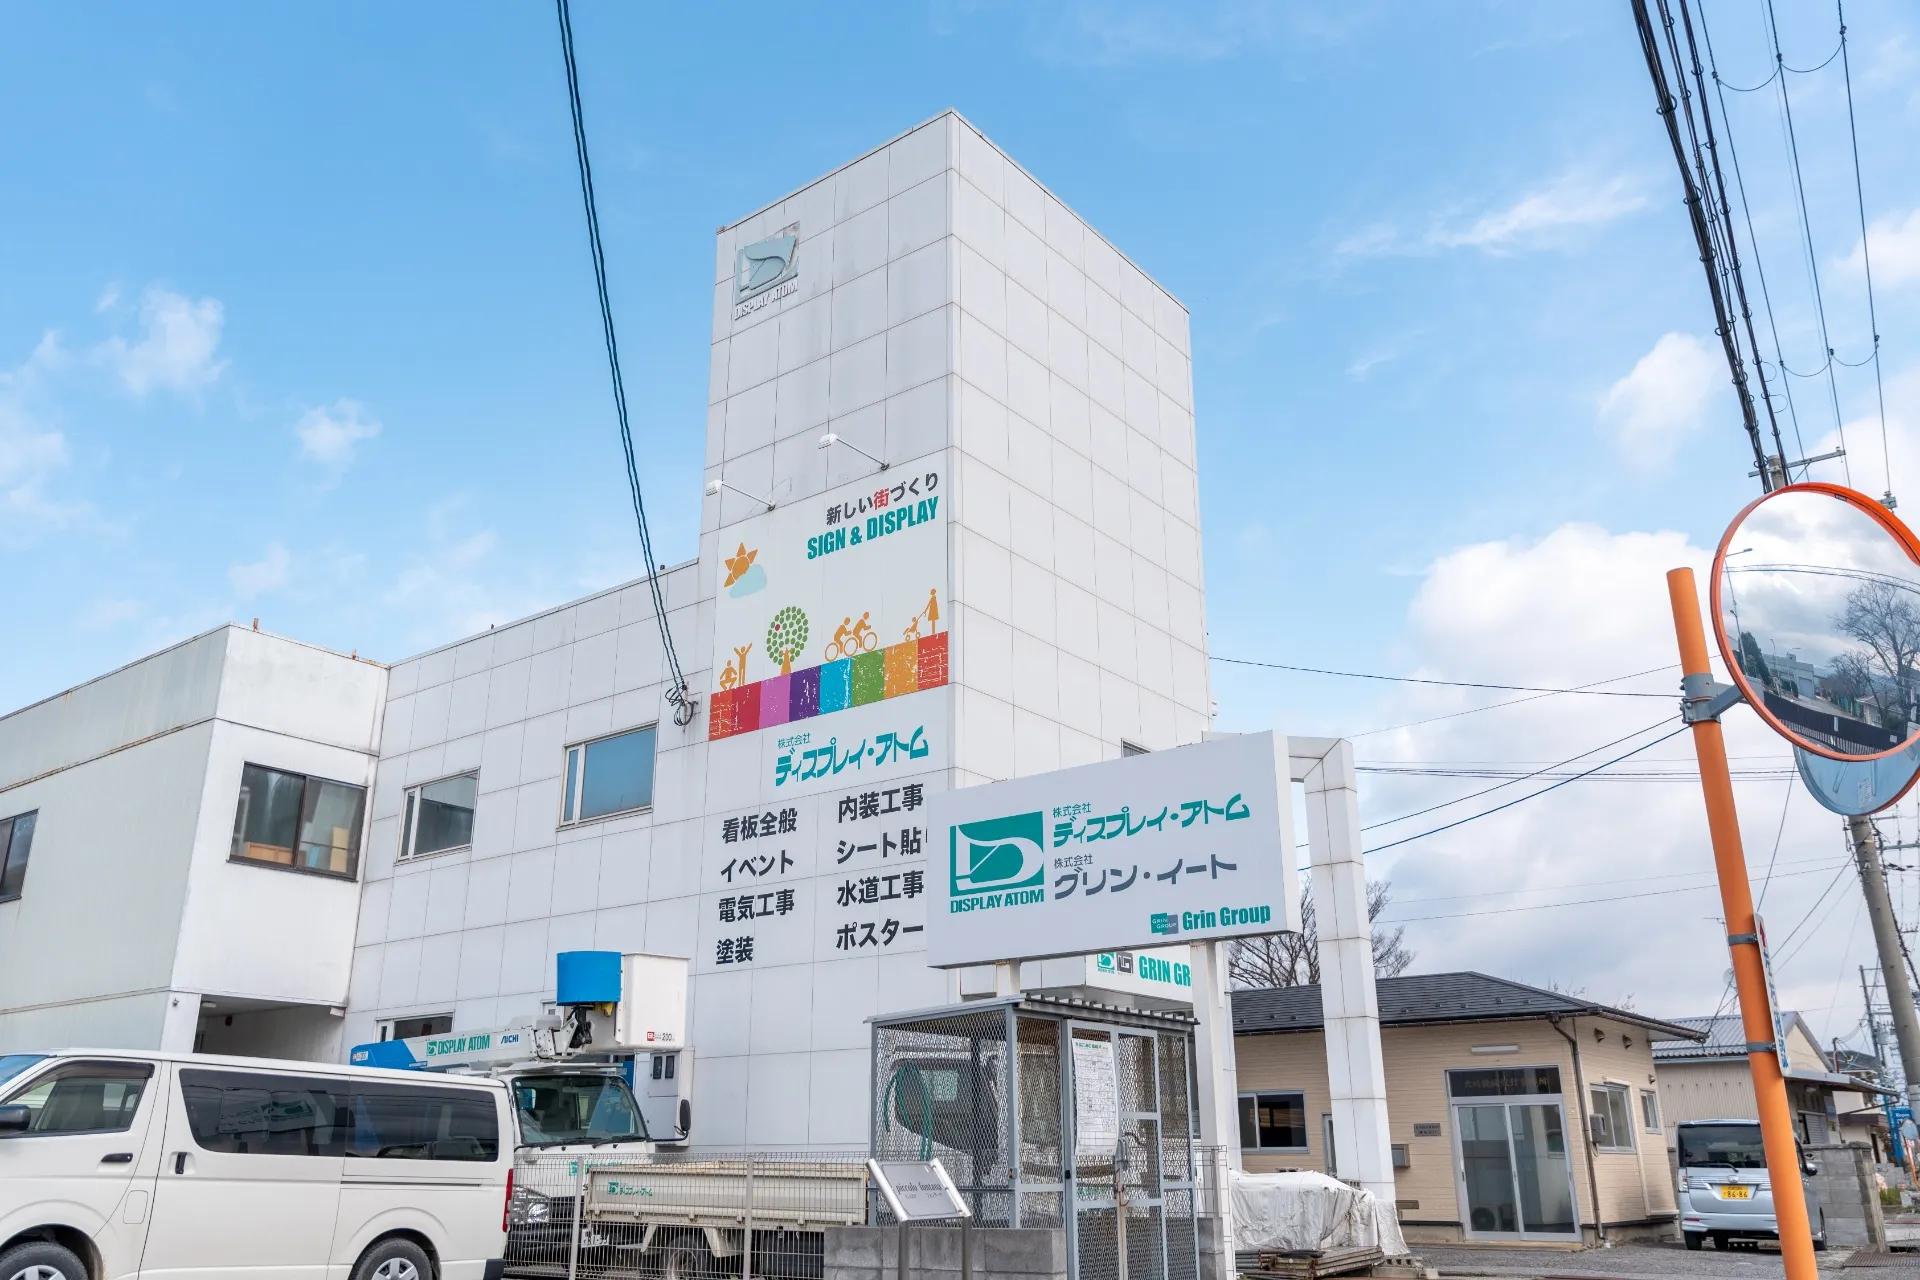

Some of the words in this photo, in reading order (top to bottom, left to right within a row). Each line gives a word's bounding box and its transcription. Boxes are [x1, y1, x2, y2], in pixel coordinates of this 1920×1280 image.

[735, 293, 770, 320] DISPLAY
[771, 278, 798, 302] ATOM
[827, 472, 939, 526] 新しい街づくり
[807, 527, 847, 560] SIGN
[849, 525, 863, 547] &
[866, 495, 939, 541] DISPLAY
[775, 725, 929, 787] ディスプレイ・アトム
[777, 732, 811, 749] 株式会社
[838, 783, 924, 824] 内装工事
[1053, 802, 1092, 818] 株式会社
[722, 807, 798, 844] 看板全般
[1053, 793, 1251, 848] ディスプレイ・アトム
[837, 826, 928, 865] シート貼
[1054, 854, 1093, 869] 株式会社
[720, 849, 794, 883] イベント
[1055, 853, 1238, 900] グリン・イート
[837, 870, 924, 907] 水道工事
[950, 894, 1002, 914] DISPLAY
[1004, 888, 1045, 907] ATOM
[718, 888, 795, 923] 電気工事
[1152, 917, 1168, 925] GRIN
[1182, 909, 1217, 931] Grin
[1219, 904, 1272, 928] Group
[836, 918, 924, 951] ポスター
[1156, 922, 1178, 930] GROUP
[716, 936, 754, 965] 塗装
[1138, 955, 1172, 984] GRIN
[437, 1037, 467, 1056] DISPLAY
[468, 1034, 491, 1052] ATOM
[501, 1033, 520, 1045] AICHI
